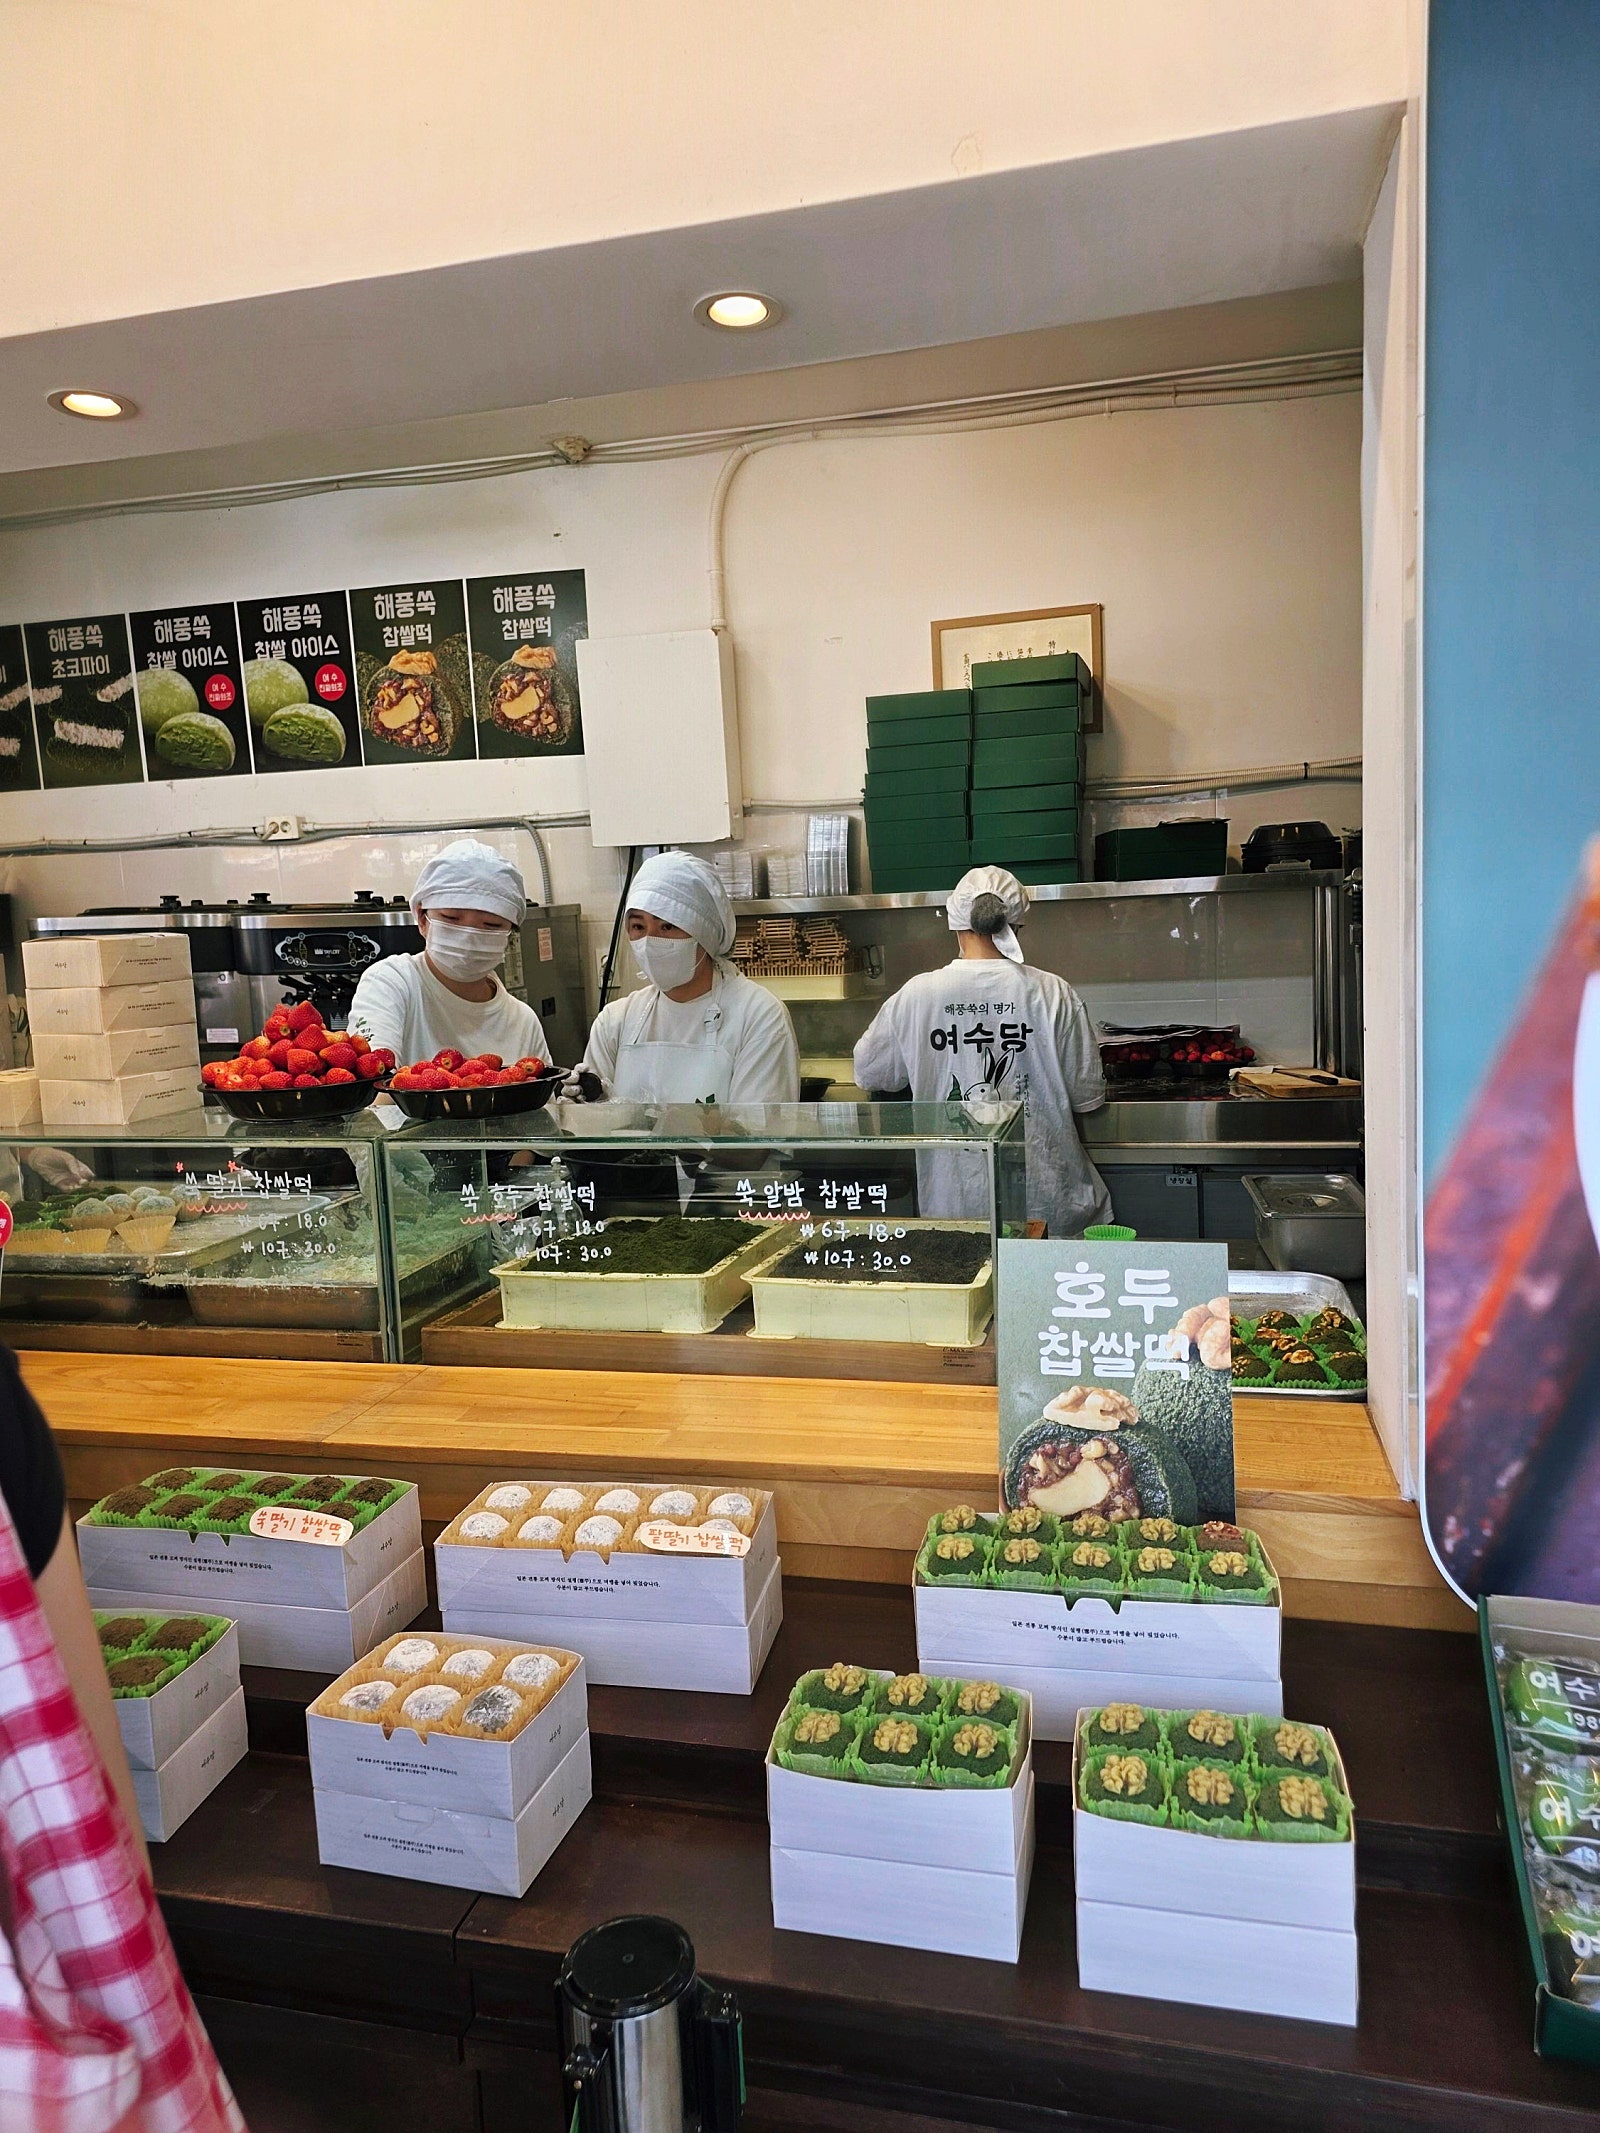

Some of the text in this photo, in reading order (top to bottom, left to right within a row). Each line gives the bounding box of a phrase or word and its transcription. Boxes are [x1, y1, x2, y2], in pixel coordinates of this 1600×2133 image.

[373, 590, 437, 620] 해풍쑥
[492, 583, 556, 614] 해풍쑥
[153, 614, 211, 644] 해풍쑥
[261, 603, 323, 633] 해풍쑥
[501, 616, 552, 641] 찹쌀떡
[47, 624, 104, 653] 해풍쑥
[254, 634, 340, 661] 찹쌀 아이스
[382, 623, 432, 648] 찹쌀떡
[51, 654, 111, 679] 초코파이
[146, 645, 229, 670] 찹쌀 아이스
[944, 1002, 1016, 1016] 해풍쑥의 명가
[930, 1022, 1034, 1054] 여수당
[207, 1169, 243, 1199] 딸기
[254, 1170, 312, 1201] 찹쌀떡
[460, 1183, 480, 1212] 쑥
[534, 1181, 595, 1212] 찹쌀떡
[735, 1178, 888, 1213] 쑥 알밤 찹쌀떡
[297, 1212, 328, 1229] 18.0
[575, 1220, 605, 1236] 18.0
[868, 1223, 906, 1243] 18.0
[304, 1241, 336, 1258] 30.0
[579, 1246, 612, 1262] 30.0
[872, 1251, 912, 1271] 30.0
[1051, 1261, 1179, 1325] 호두
[1038, 1325, 1190, 1380] 찹쌀떡
[301, 1514, 342, 1541] 찹쌀떡
[693, 1532, 743, 1552] 찹쌀떡
[1529, 1670, 1600, 1701] 여수
[1564, 1711, 1600, 1730] 198
